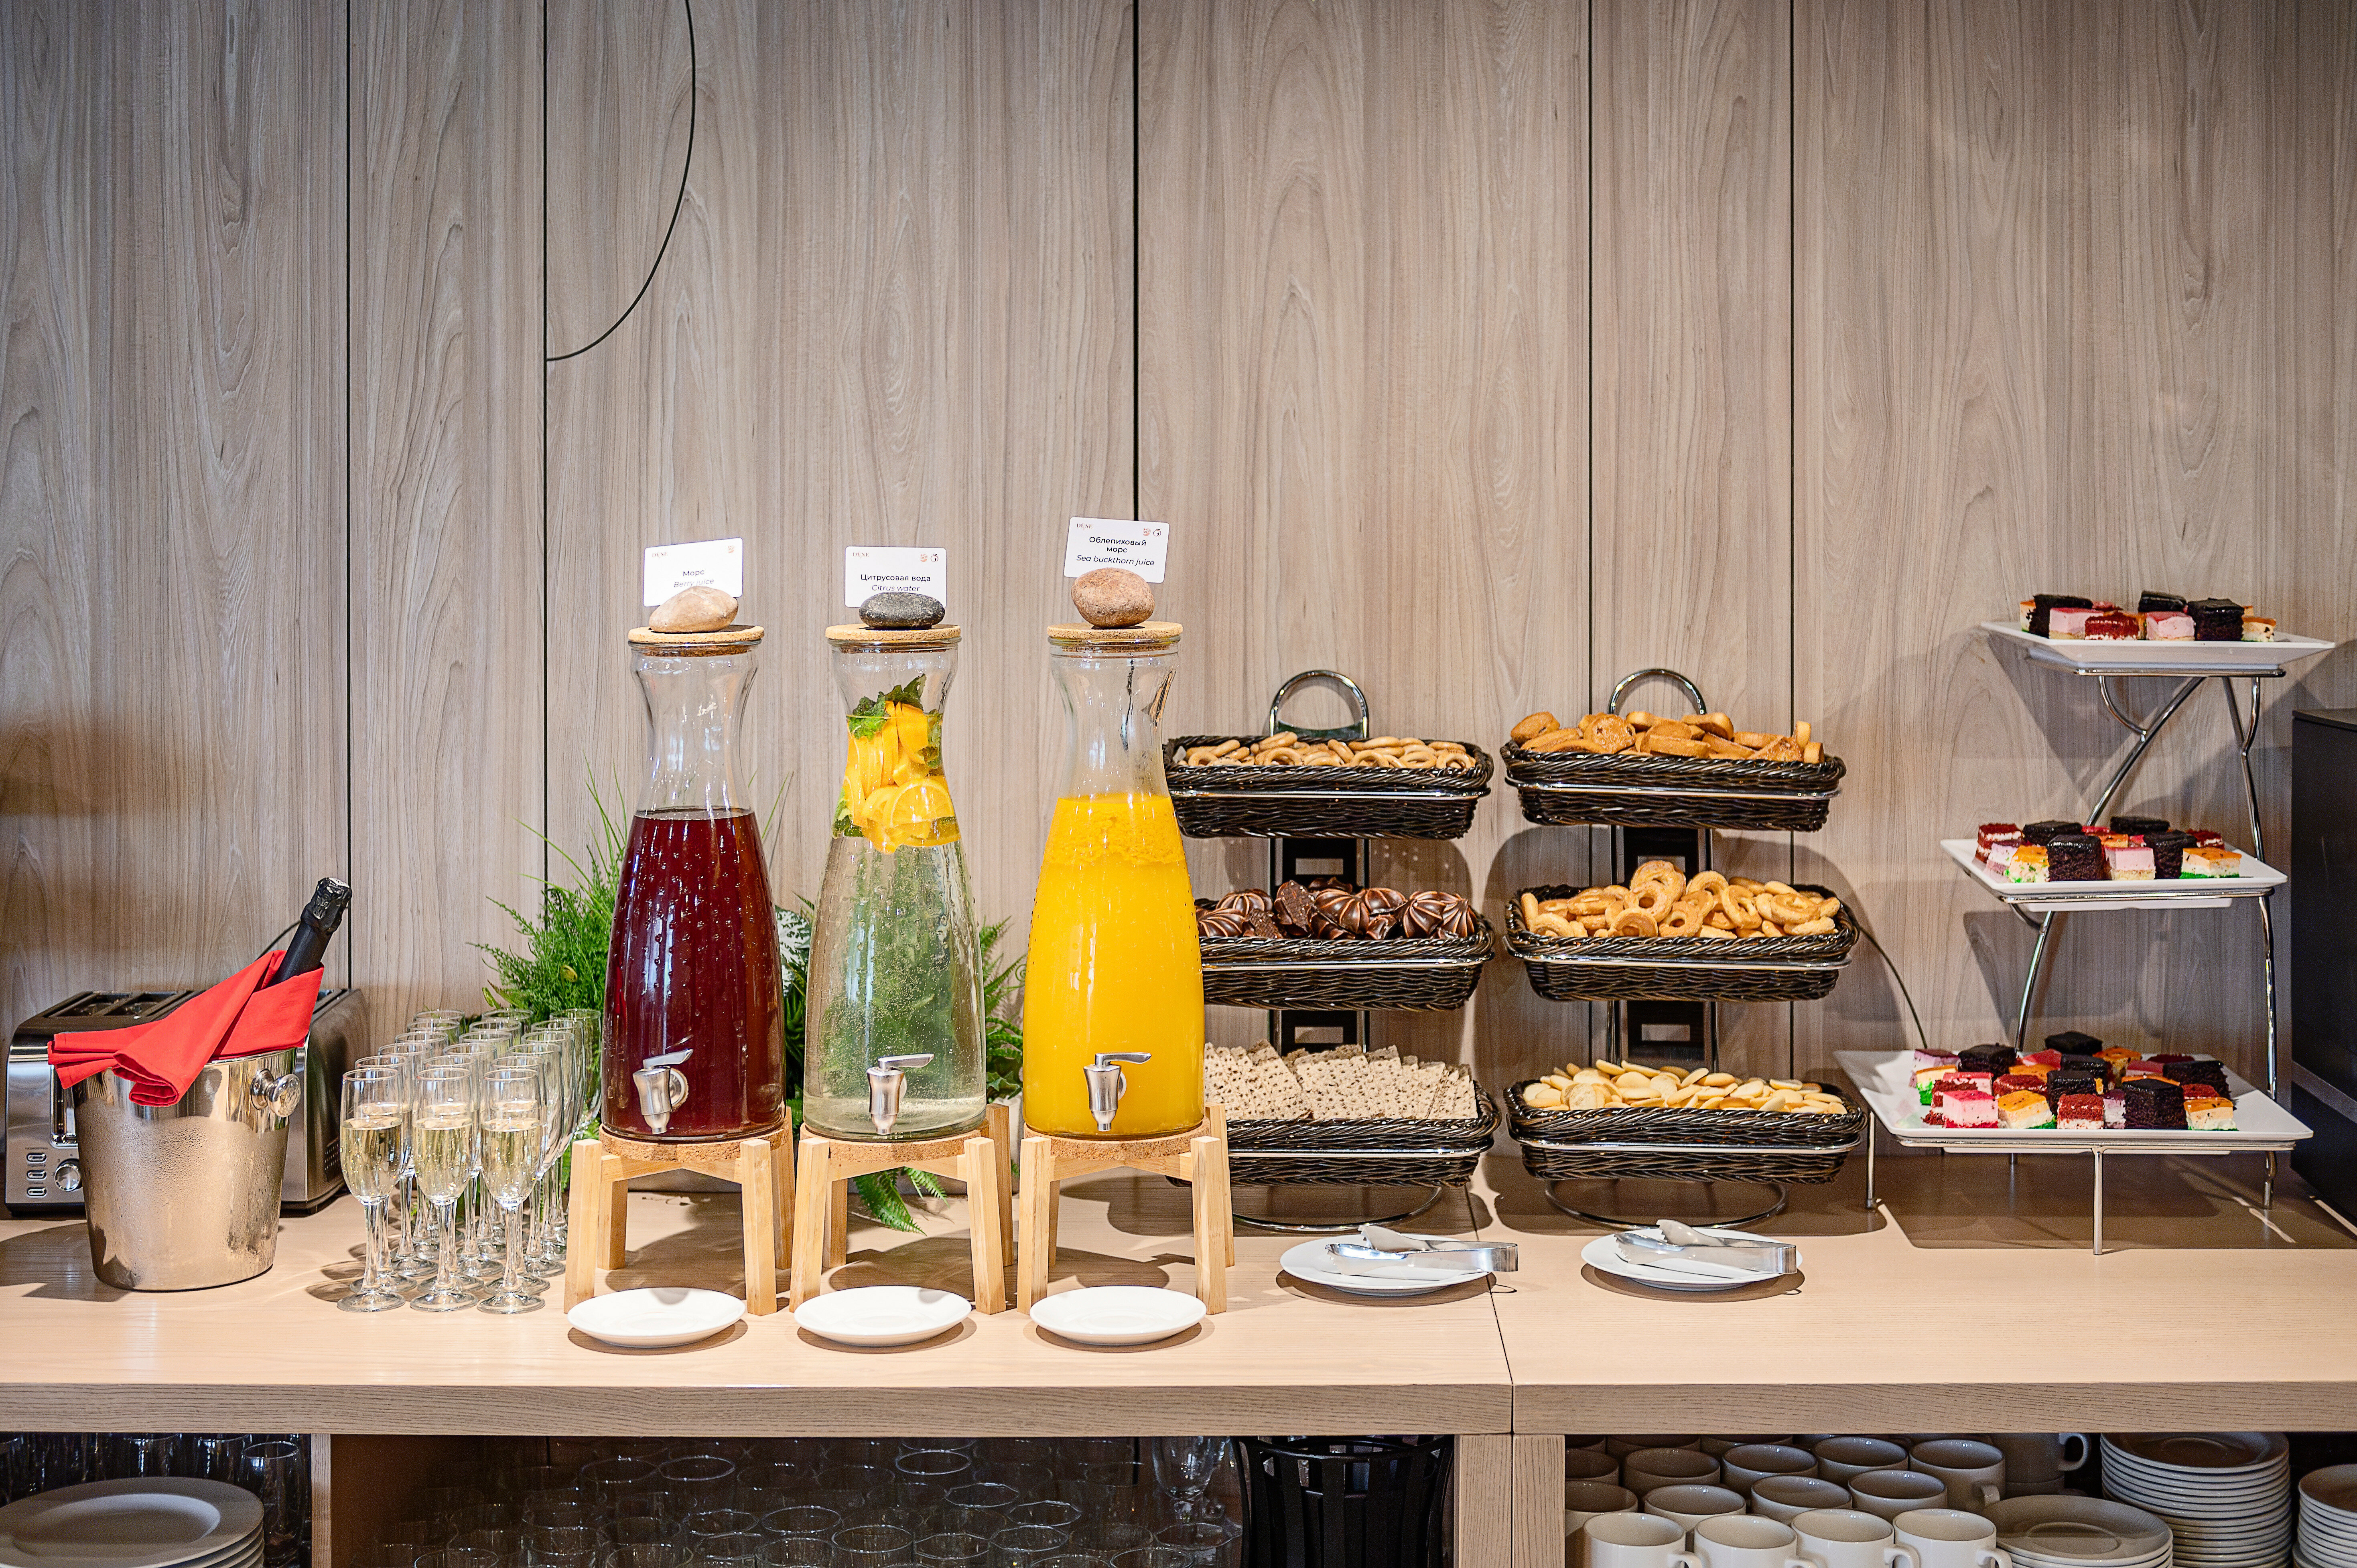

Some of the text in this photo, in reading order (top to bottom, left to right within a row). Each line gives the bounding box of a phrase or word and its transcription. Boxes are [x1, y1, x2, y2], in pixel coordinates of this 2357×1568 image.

[1089, 536, 1146, 546] Облепиховый
[1093, 555, 1134, 564] buckthorn
[861, 574, 909, 582] Цитрусовая
